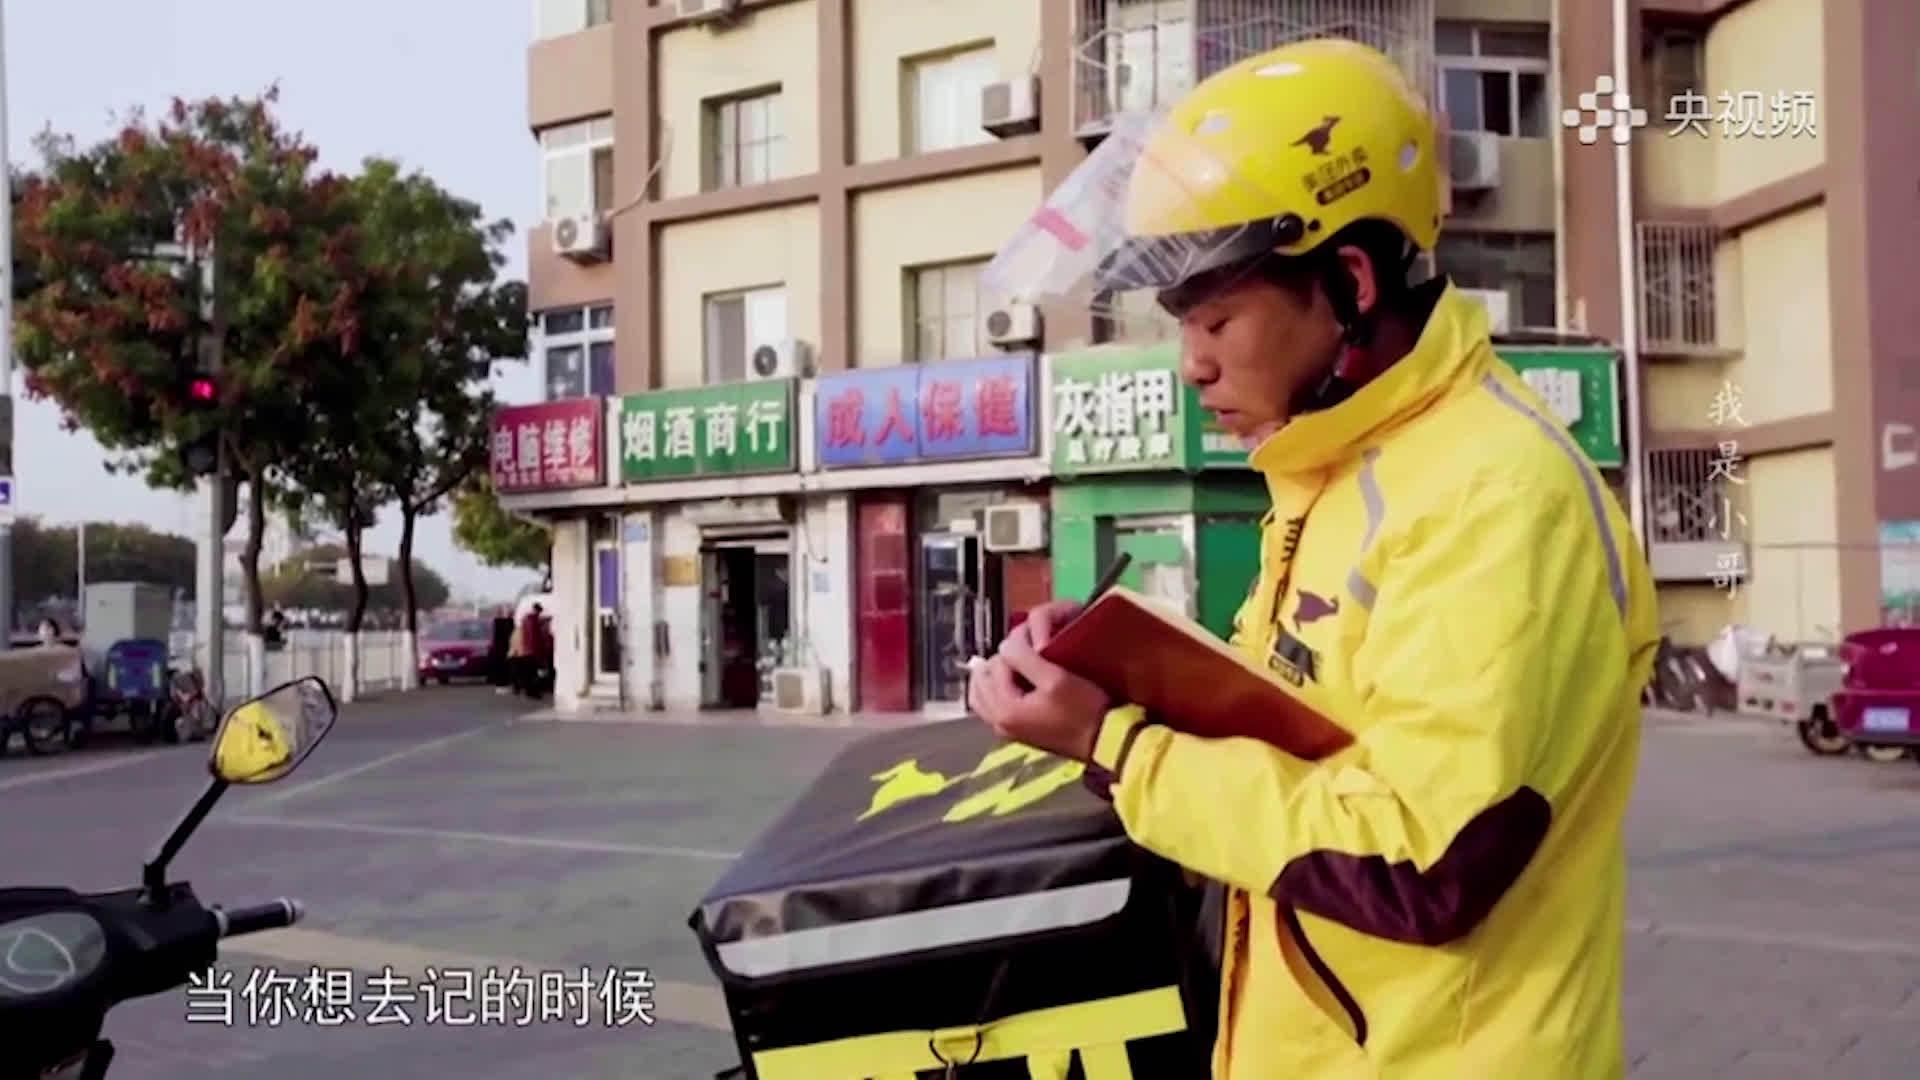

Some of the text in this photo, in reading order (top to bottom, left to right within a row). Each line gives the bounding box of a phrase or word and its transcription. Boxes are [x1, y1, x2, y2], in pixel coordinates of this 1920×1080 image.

[624, 400, 782, 461] 烟酒商行
[827, 375, 1019, 447] 成人保健
[1054, 368, 1173, 434] 灰指甲
[495, 416, 595, 473] 电脑维修
